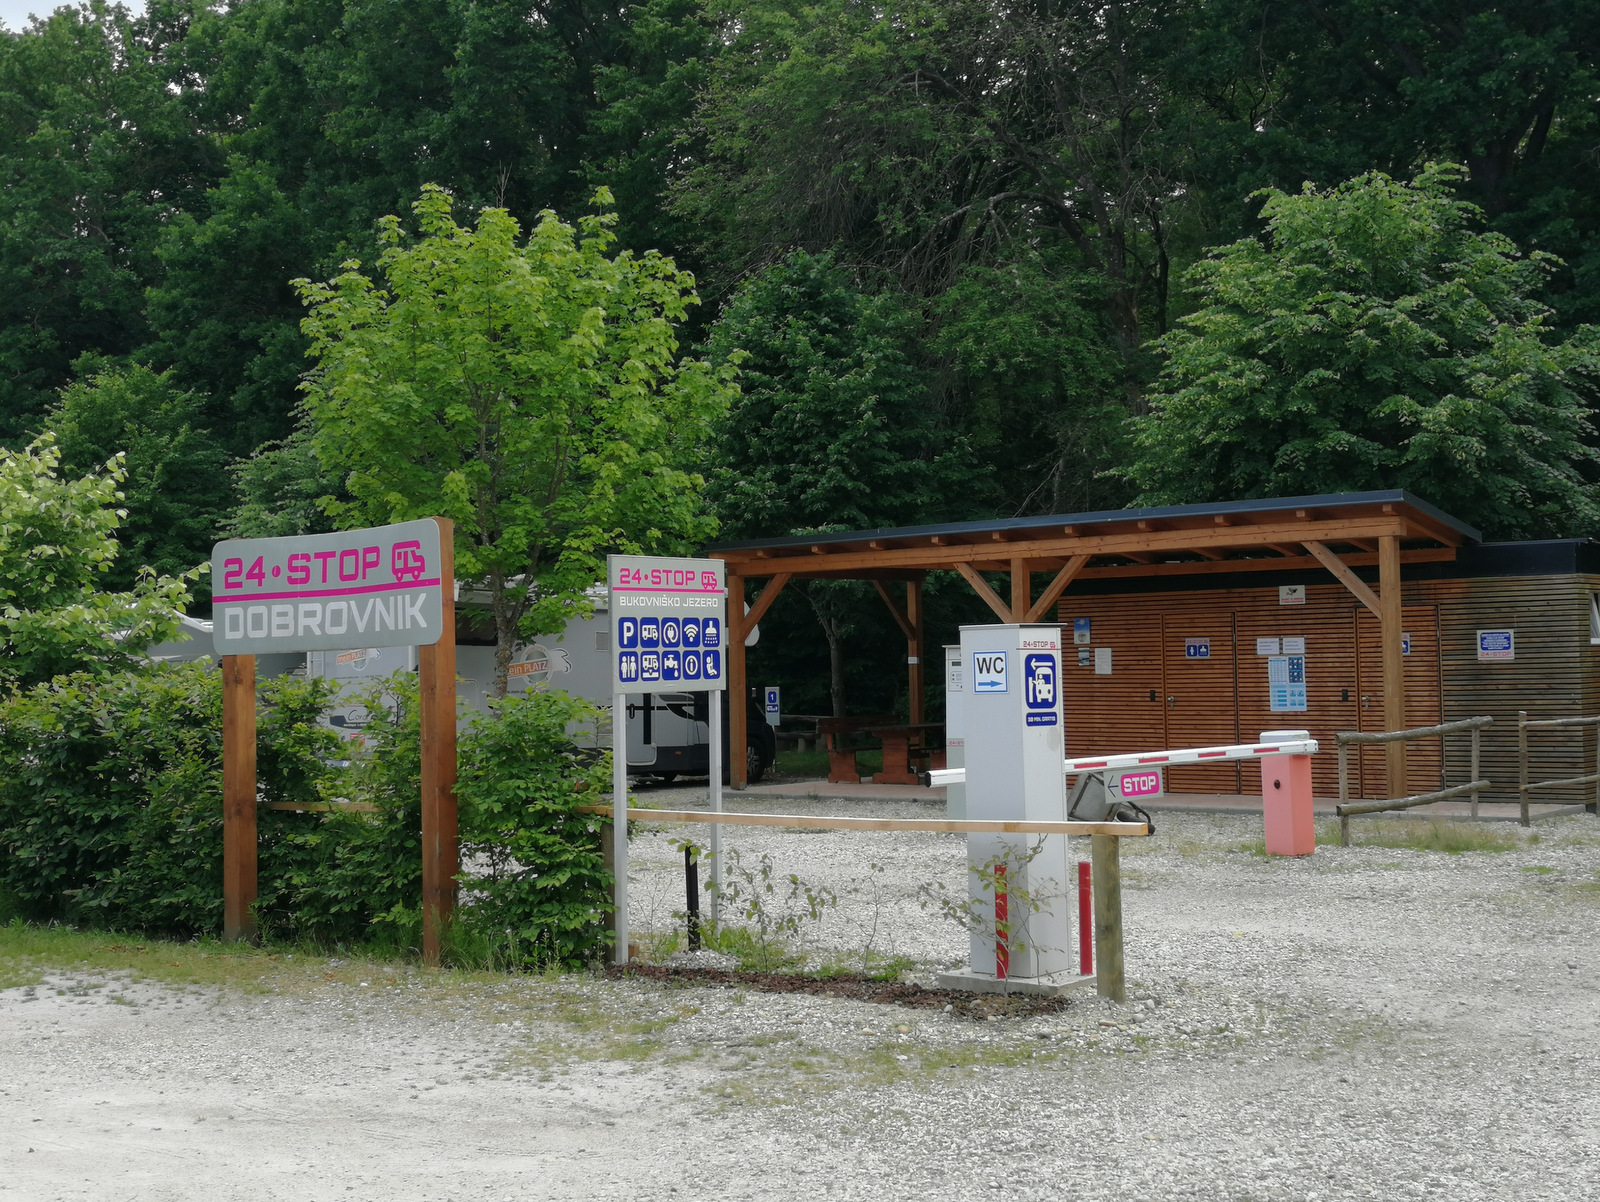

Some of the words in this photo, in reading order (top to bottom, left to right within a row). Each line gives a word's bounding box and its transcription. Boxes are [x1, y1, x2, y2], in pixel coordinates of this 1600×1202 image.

[619, 593, 681, 607] BUKOVNIŠKO
[682, 597, 718, 608] JEZERO
[224, 592, 428, 640] DOBROVNIK
[623, 621, 635, 646] P
[351, 649, 366, 660] PLATZ
[508, 666, 523, 676] ein
[524, 660, 547, 673] PLATZ
[976, 657, 1004, 675] WC
[1123, 775, 1156, 793] STOP
